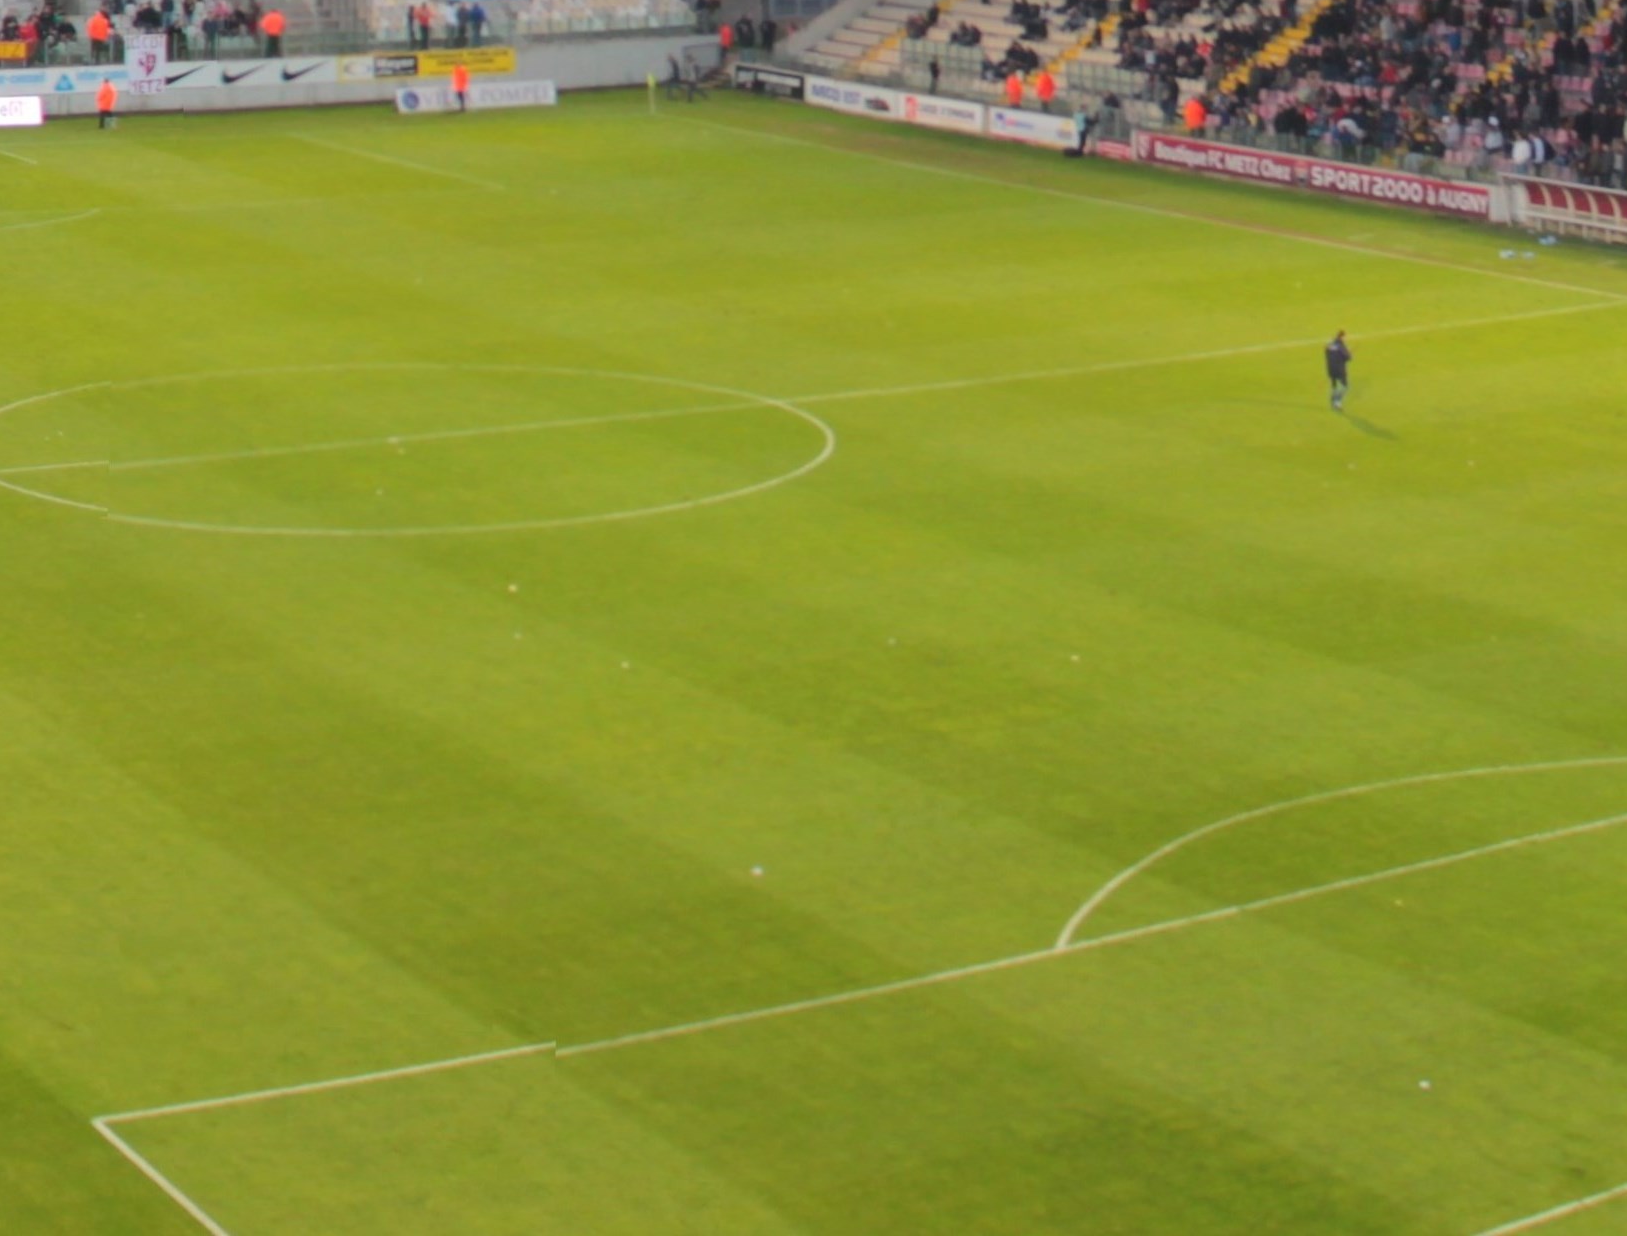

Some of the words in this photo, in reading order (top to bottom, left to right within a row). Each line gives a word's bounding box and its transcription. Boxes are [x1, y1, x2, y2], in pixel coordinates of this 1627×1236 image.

[1154, 141, 1207, 167] Boutique
[1208, 150, 1223, 168] FC
[1224, 152, 1259, 175] METZ
[1259, 156, 1292, 181] Chez
[1310, 166, 1423, 203] SPORT2000
[1437, 187, 1489, 213] AUGNY
